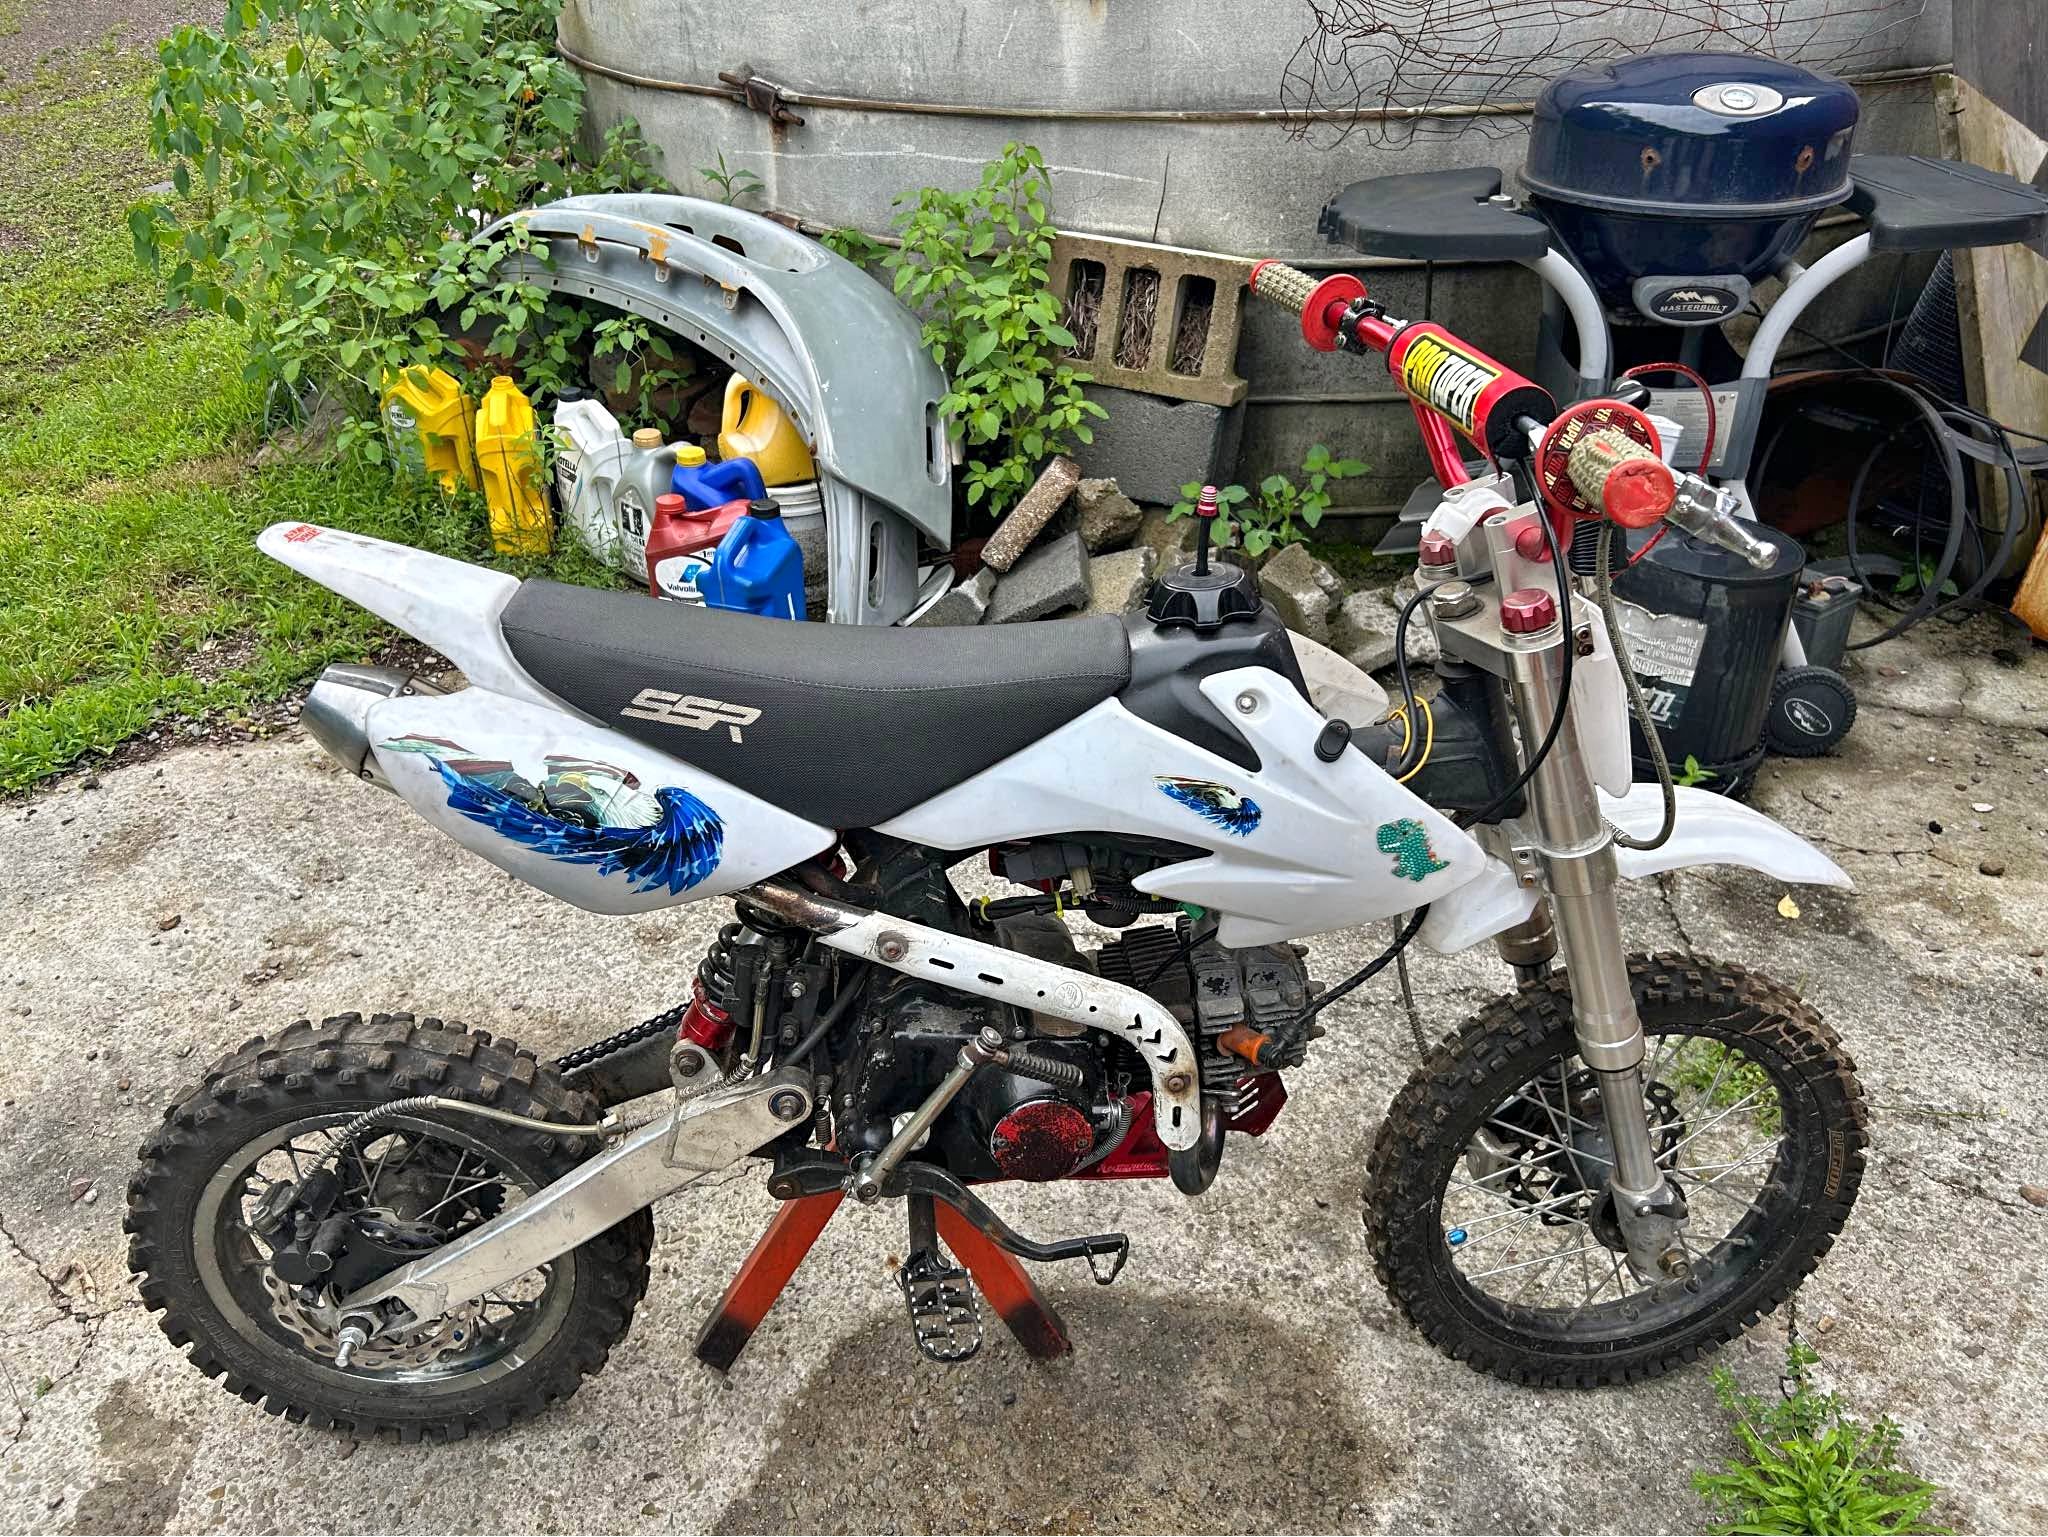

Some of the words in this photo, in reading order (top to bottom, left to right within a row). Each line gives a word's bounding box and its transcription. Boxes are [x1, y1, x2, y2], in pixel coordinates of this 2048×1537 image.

[1659, 305, 1728, 313] MASTERBUILT
[666, 583, 696, 593] Valvolin
[1652, 648, 1692, 666] Universal
[620, 688, 763, 743] SSR
